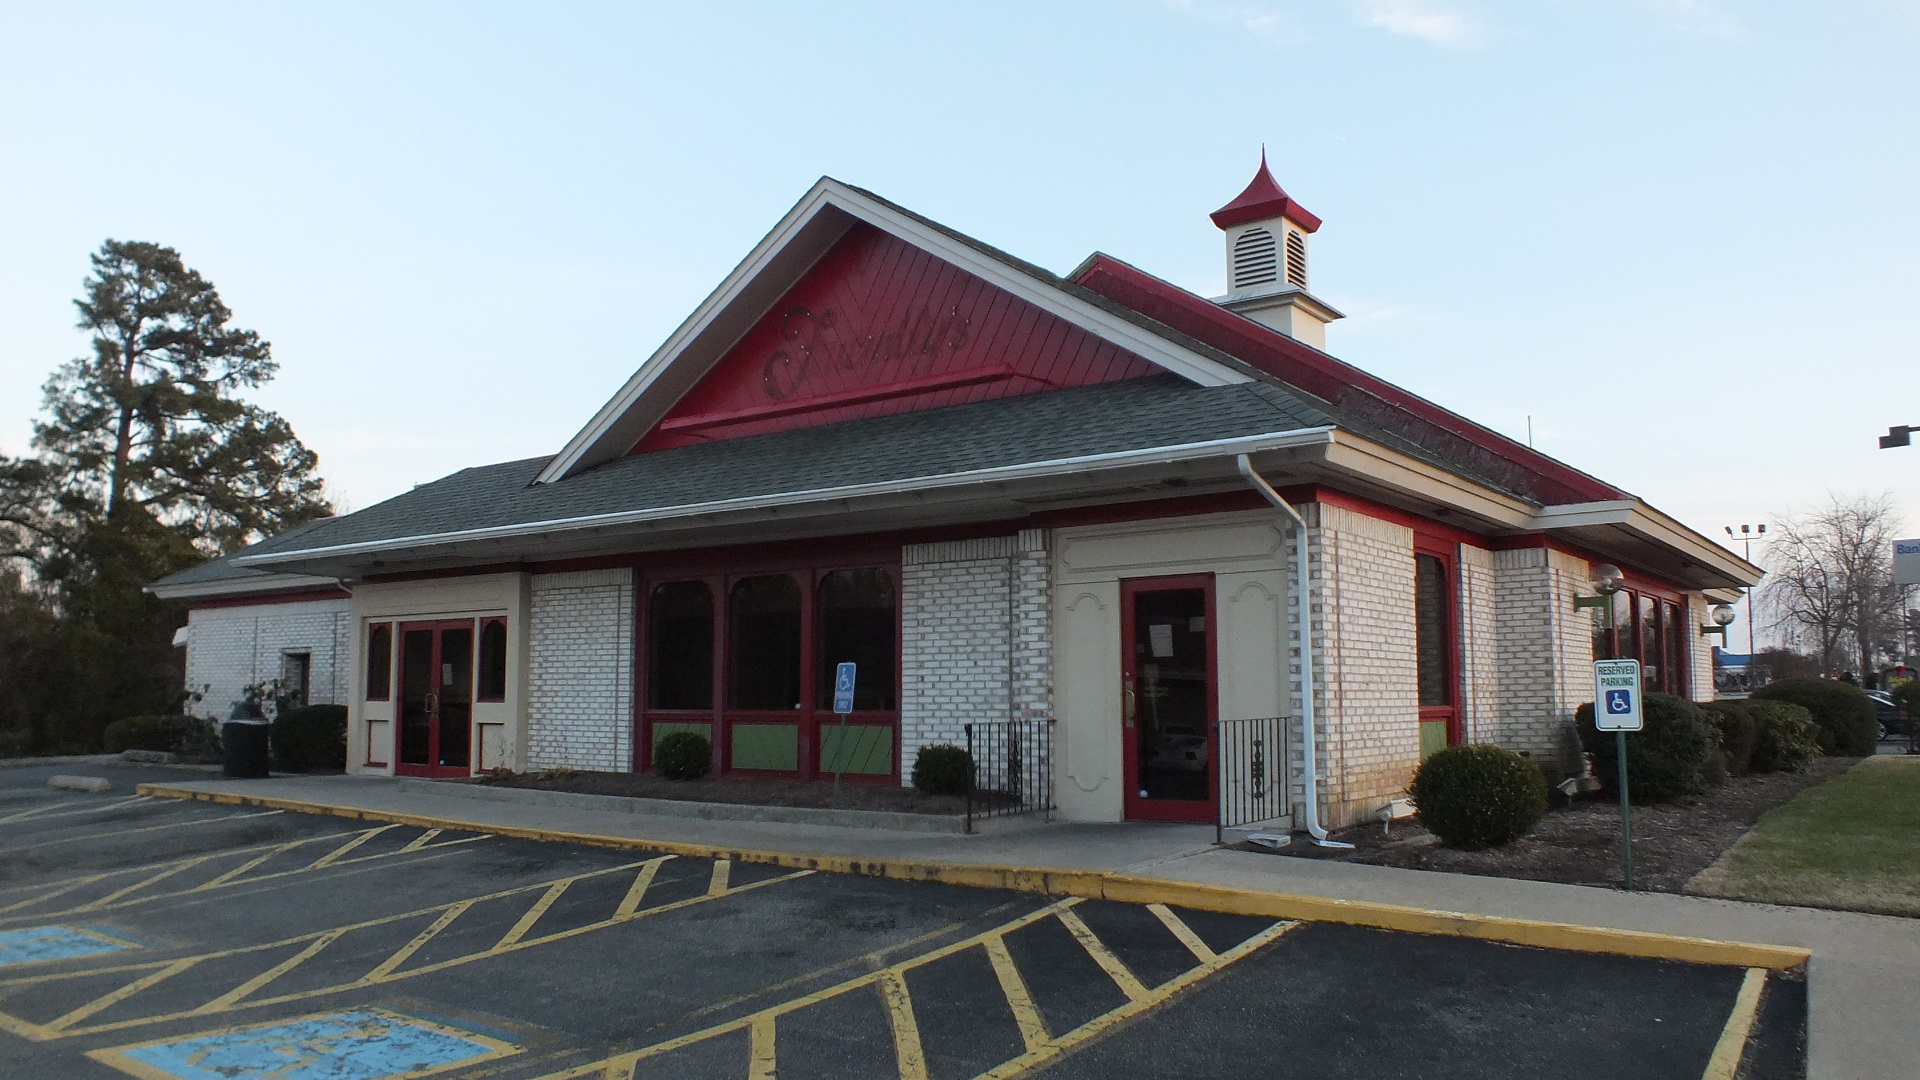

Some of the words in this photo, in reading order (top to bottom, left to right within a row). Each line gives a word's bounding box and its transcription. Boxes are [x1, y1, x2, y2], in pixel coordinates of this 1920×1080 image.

[1896, 543, 1920, 554] Ban
[1598, 665, 1635, 675] RESERVED
[1601, 677, 1634, 686] PARKING
